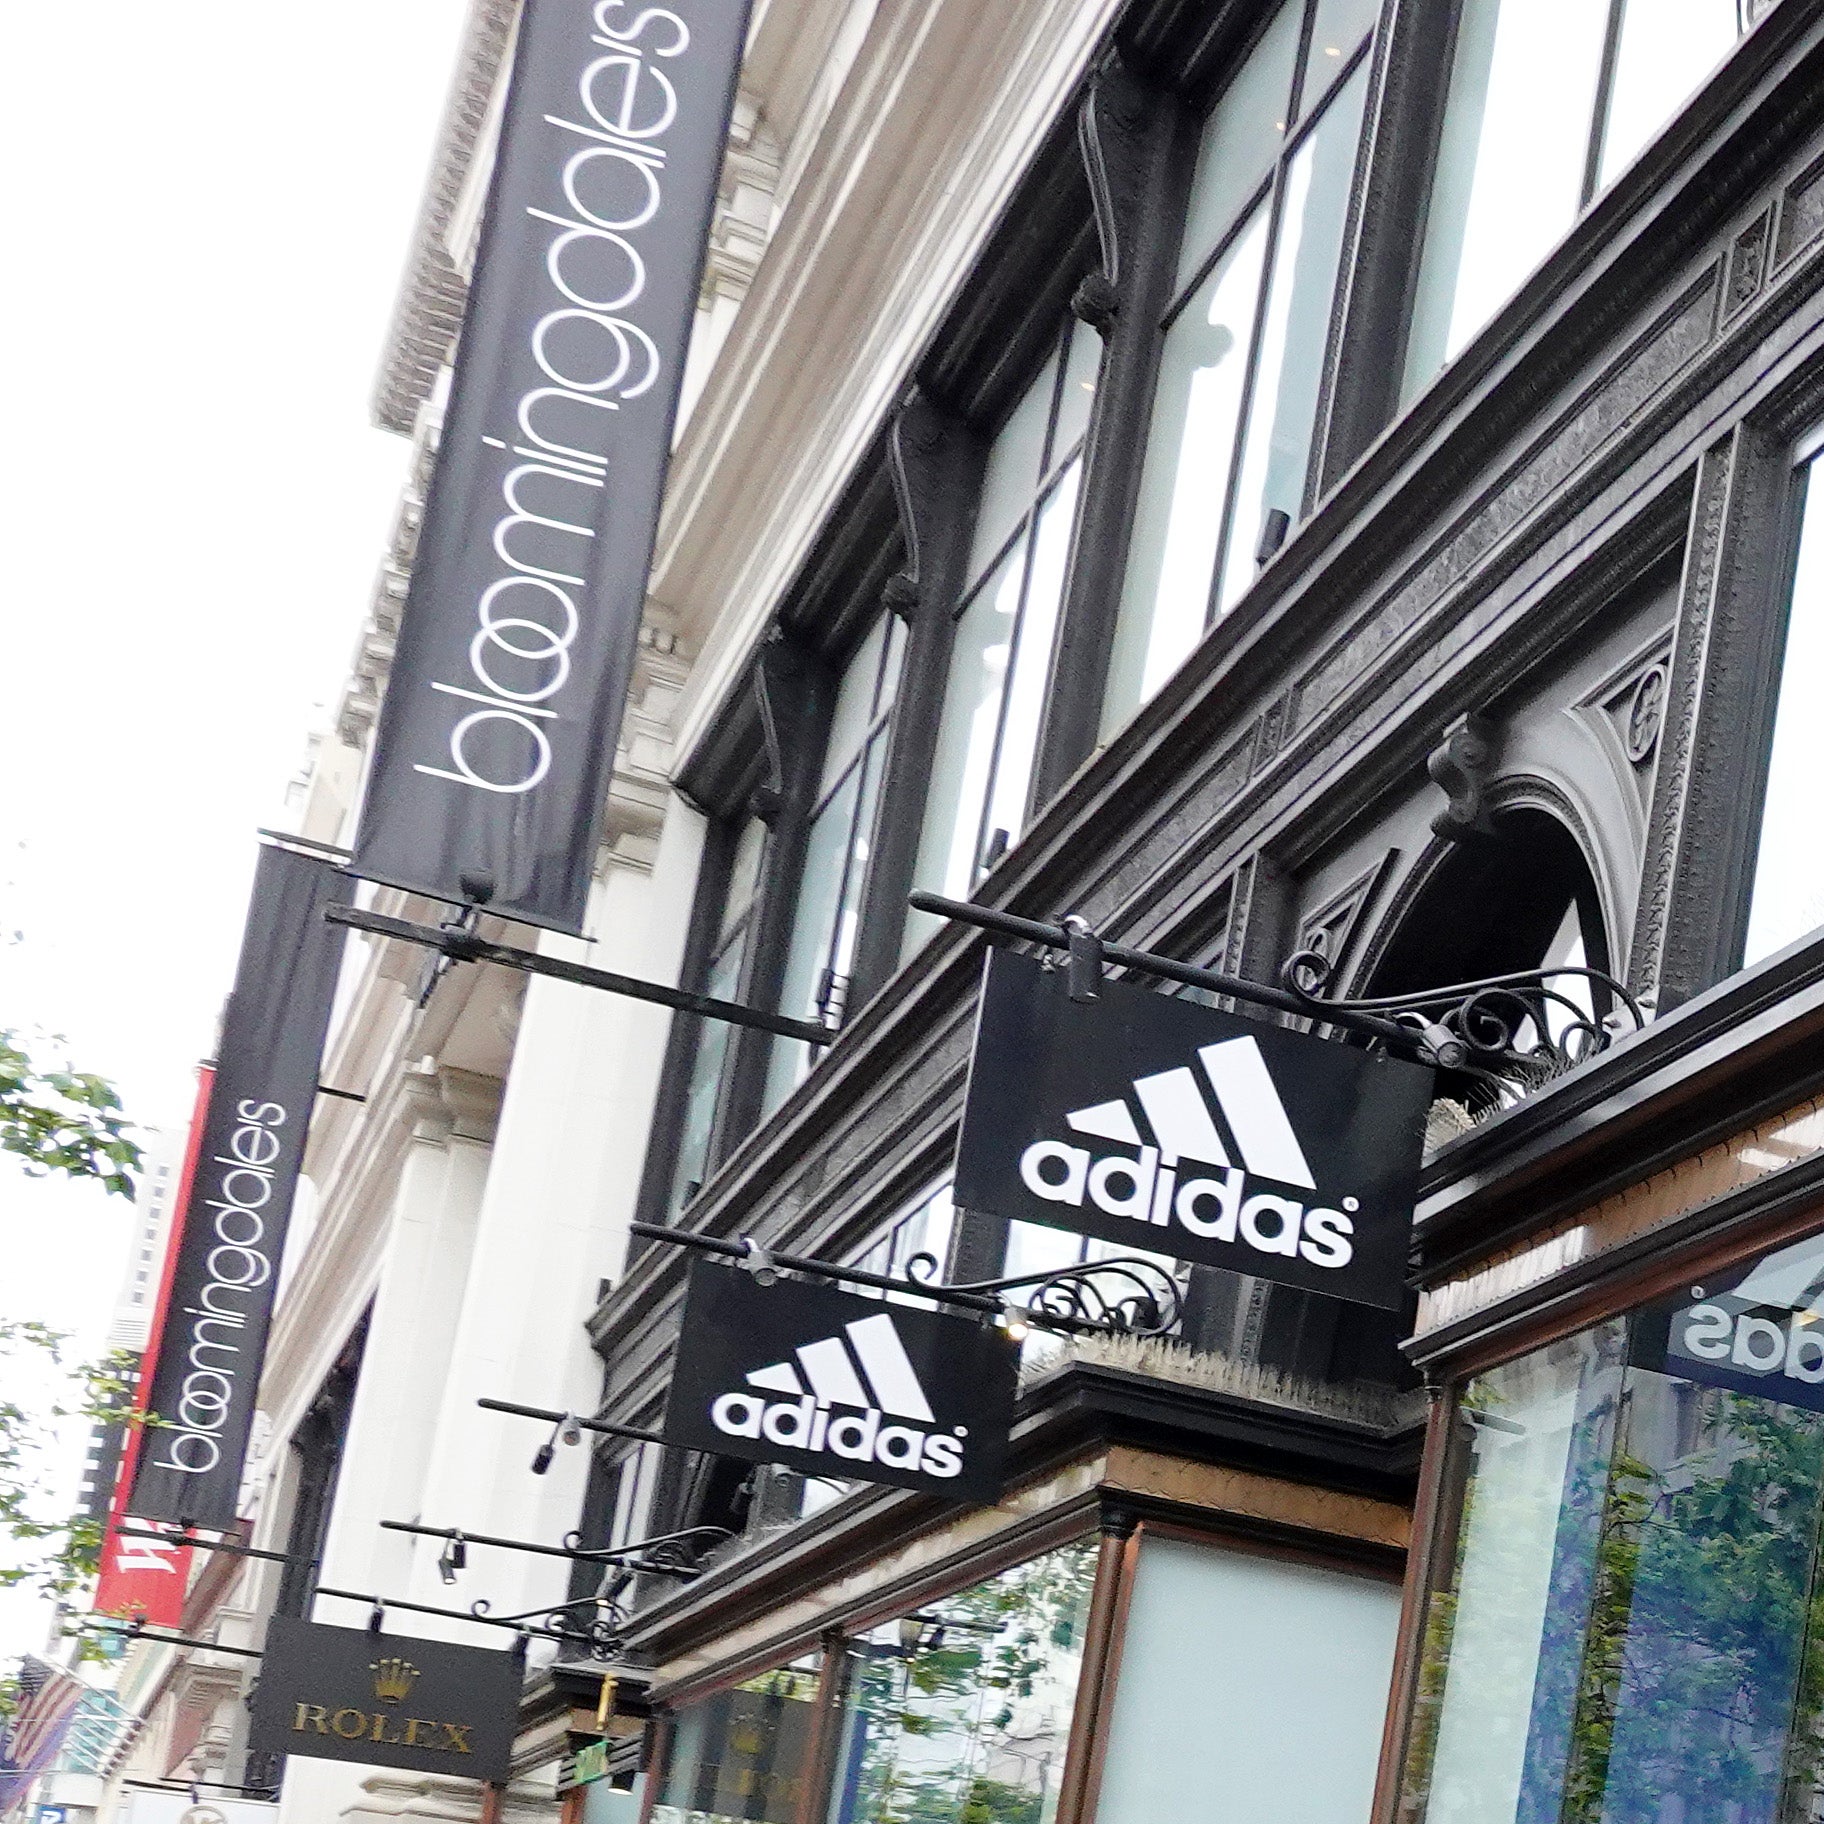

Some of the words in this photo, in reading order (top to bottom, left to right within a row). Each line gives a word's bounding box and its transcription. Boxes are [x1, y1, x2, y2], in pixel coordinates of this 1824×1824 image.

[1019, 1140, 1355, 1269] adidas
[710, 1392, 964, 1478] adidas
[291, 1701, 476, 1755] ROLEX
